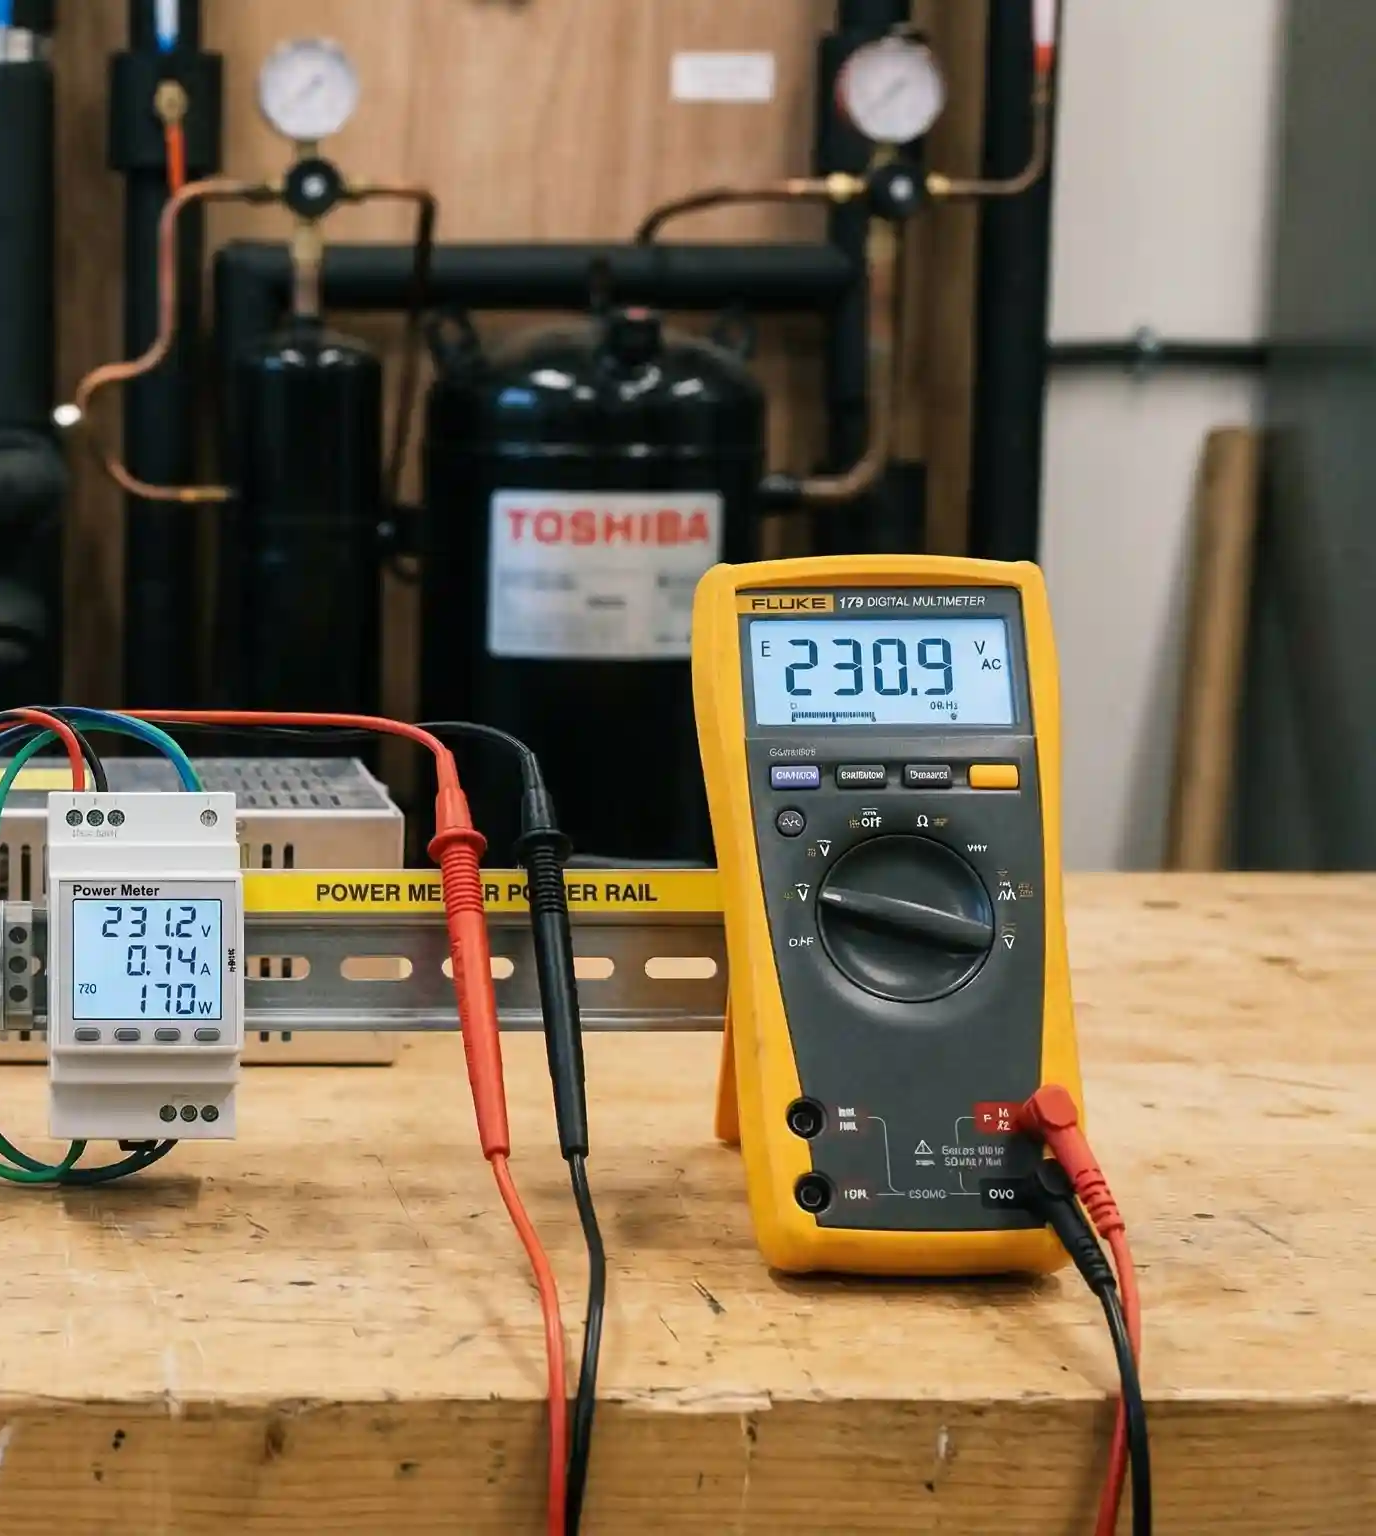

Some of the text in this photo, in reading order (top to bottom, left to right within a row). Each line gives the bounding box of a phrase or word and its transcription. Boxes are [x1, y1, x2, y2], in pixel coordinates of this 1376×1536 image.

[507, 508, 709, 545] TOSHIBA
[751, 596, 986, 610] FLUKE 179 DIGITAL MULTIMETER
[785, 638, 954, 697] 230.9
[974, 640, 986, 655] V
[981, 658, 1002, 670] AC
[72, 884, 160, 896] Power Meter
[316, 883, 401, 902] POWER
[605, 883, 659, 902] RAIL
[101, 906, 212, 938] 231.2 V
[126, 944, 211, 976] 0.74 A
[140, 983, 213, 1015] 170 W
